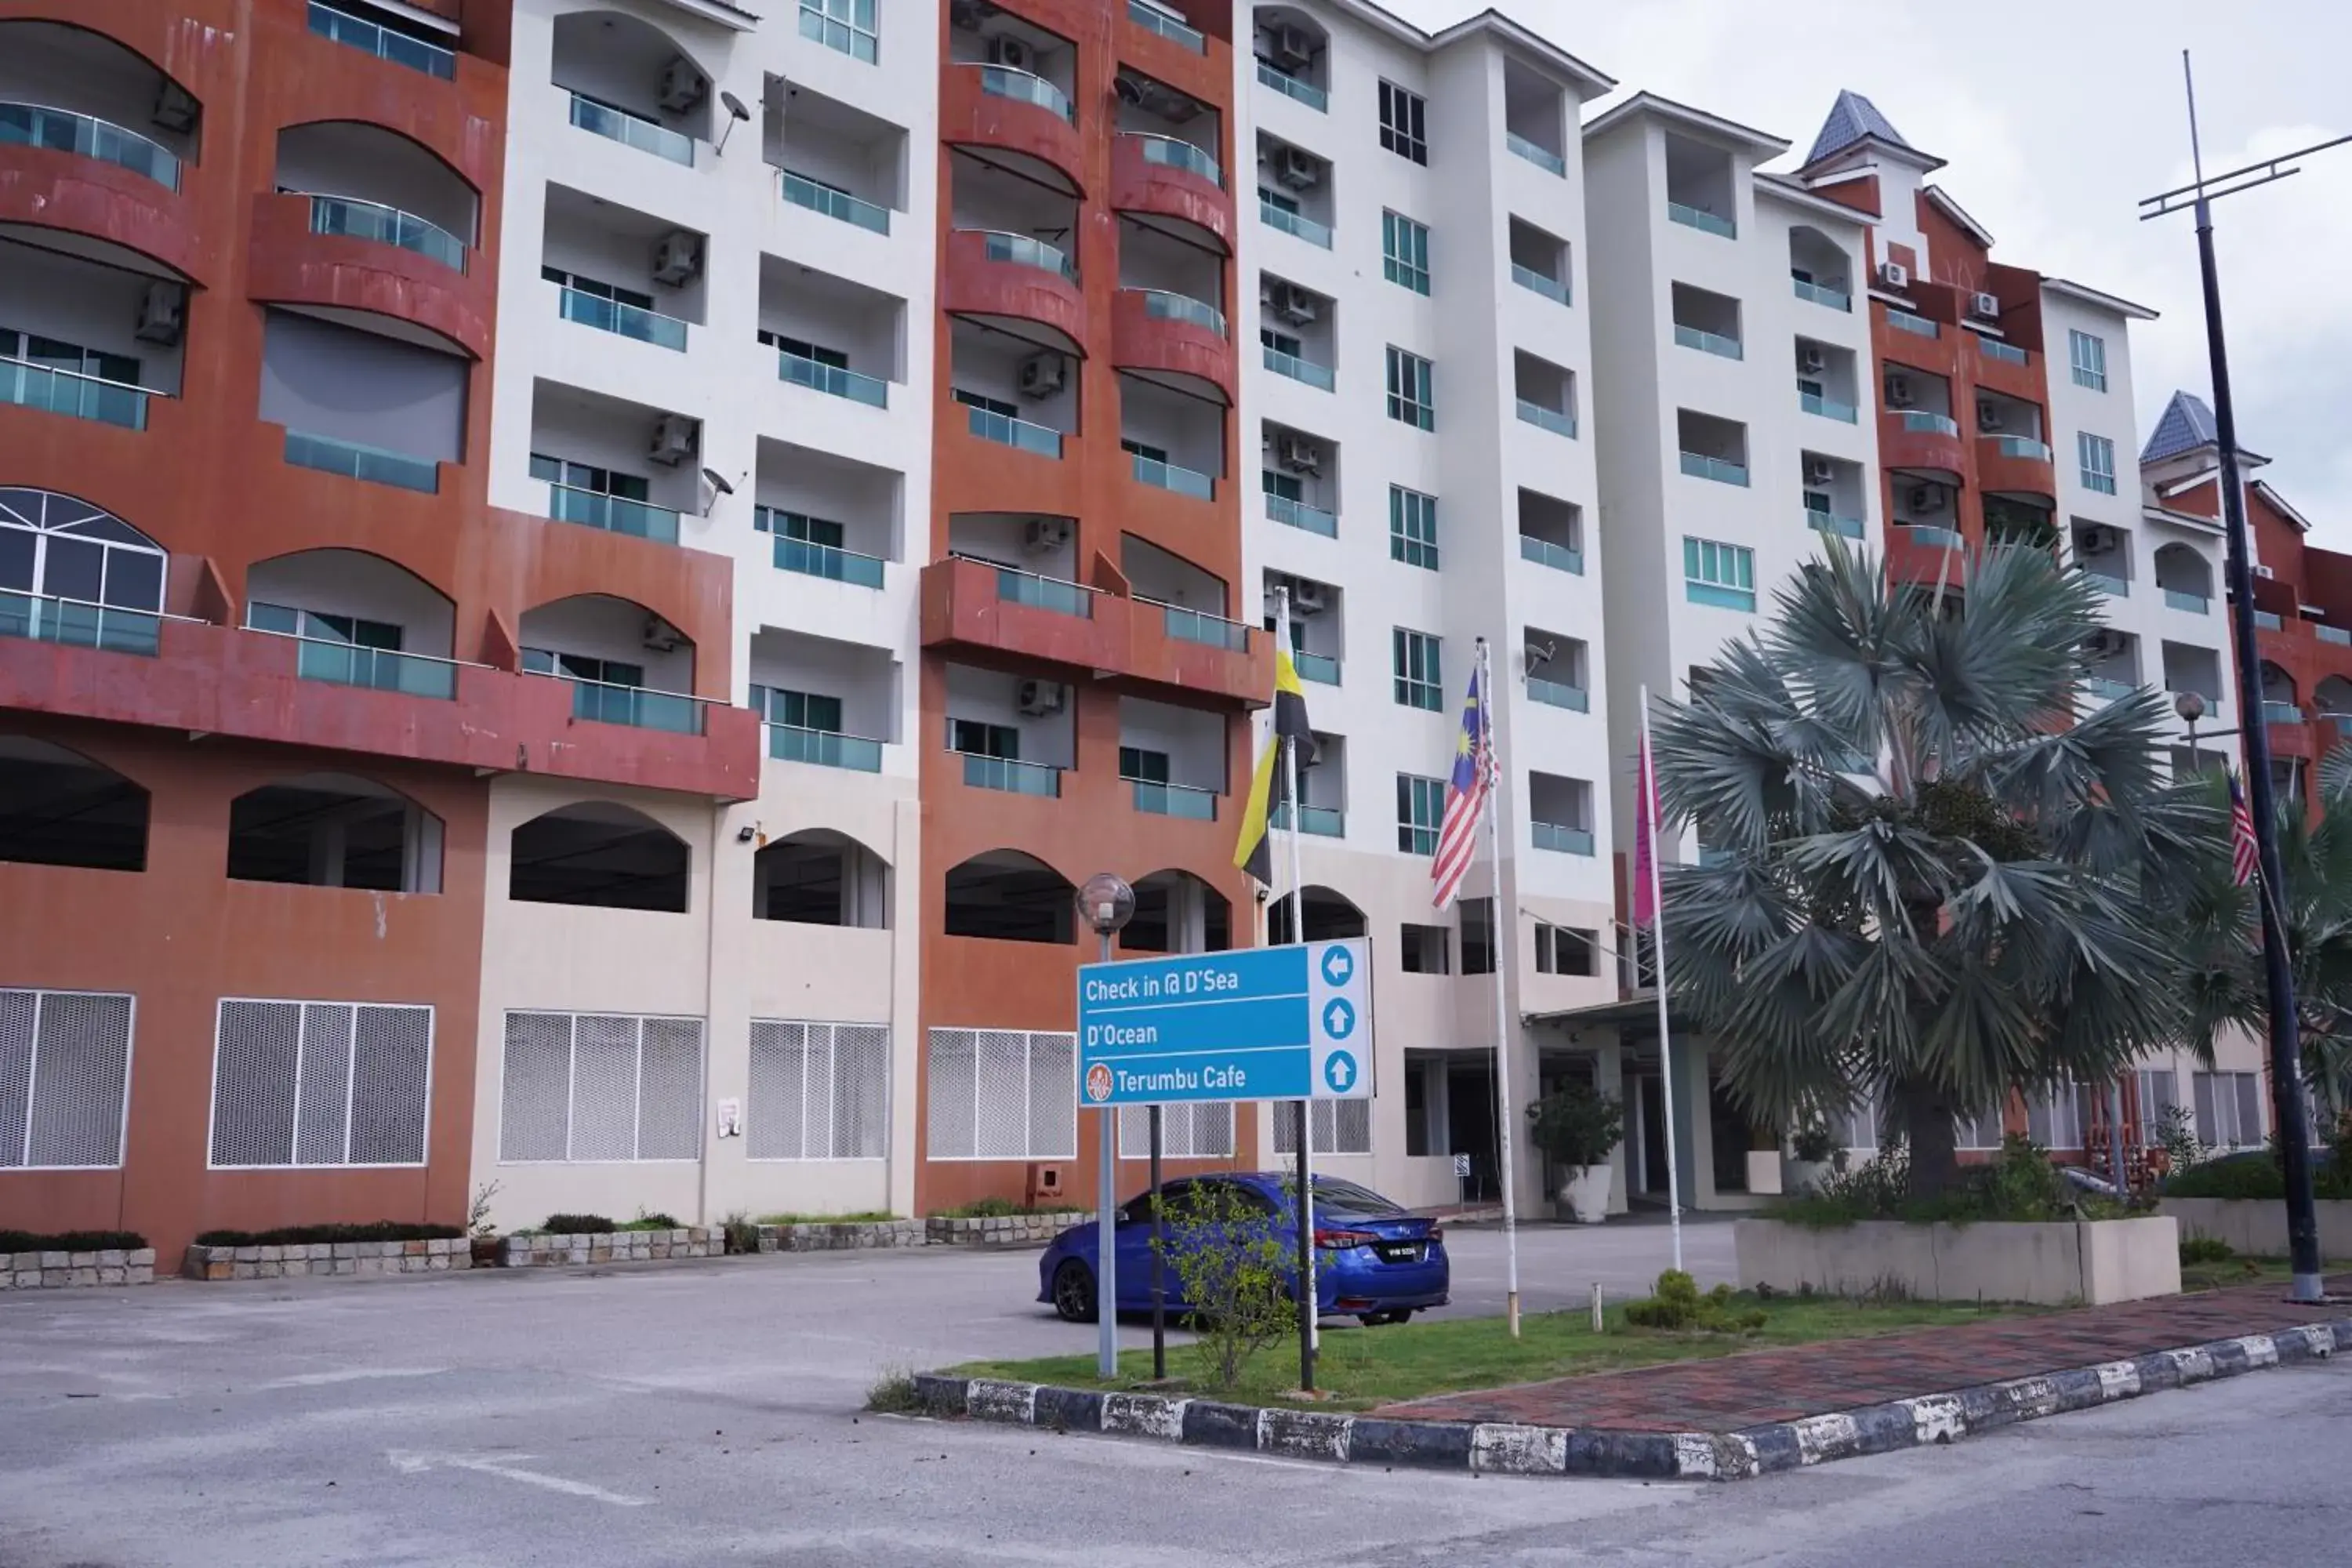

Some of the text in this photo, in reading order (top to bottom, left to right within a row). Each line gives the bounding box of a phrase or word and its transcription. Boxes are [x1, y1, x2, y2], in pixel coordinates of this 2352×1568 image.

[1086, 969, 1238, 1001] Check in @ D'Sea
[1087, 1024, 1157, 1047] D'Ocean
[1117, 1065, 1246, 1092] Terumbu Cafe
